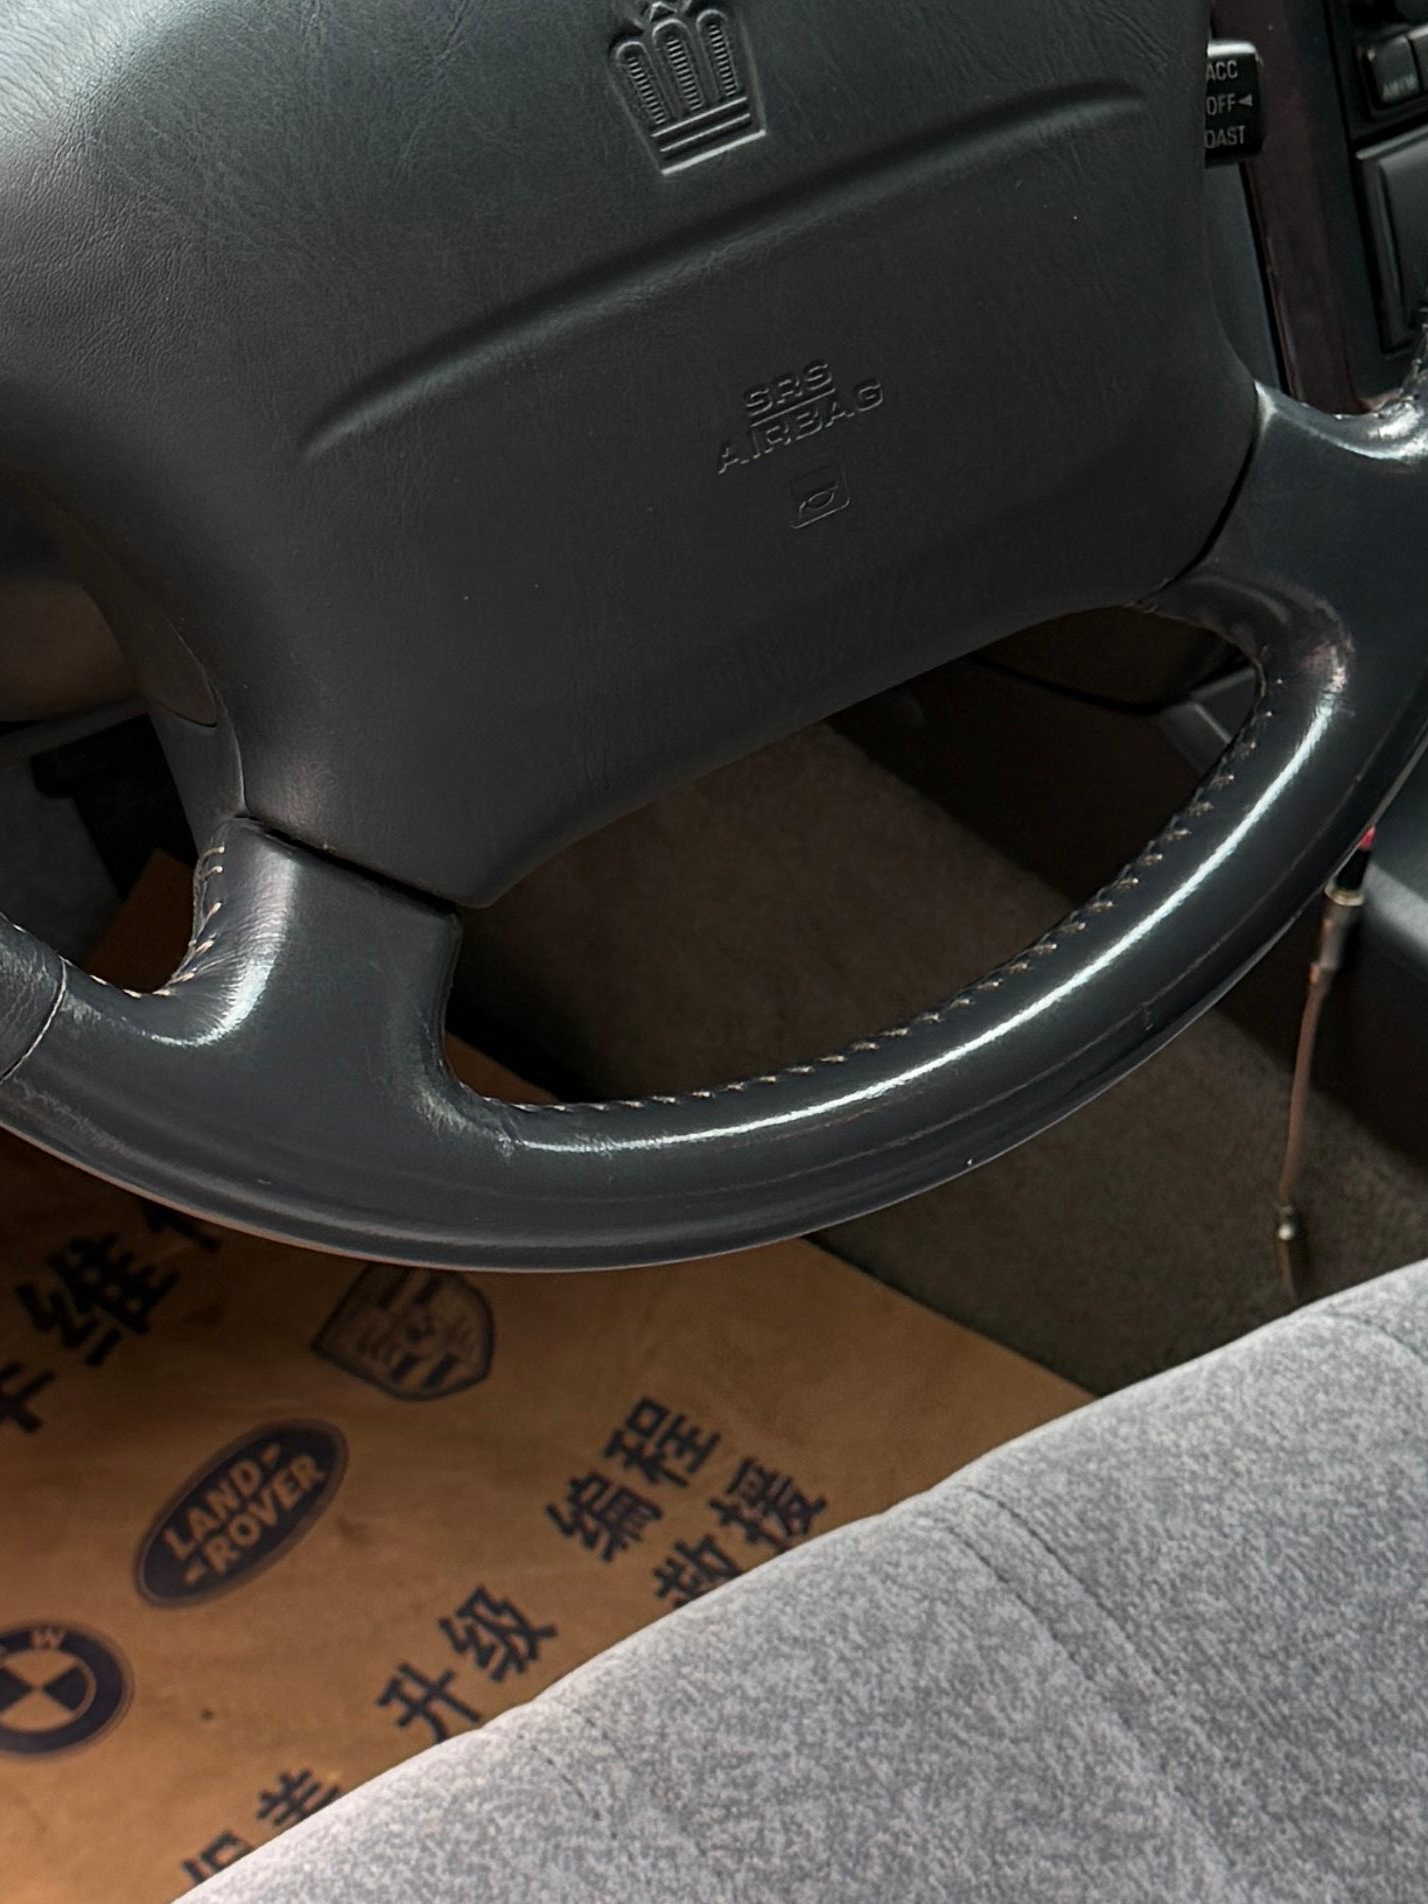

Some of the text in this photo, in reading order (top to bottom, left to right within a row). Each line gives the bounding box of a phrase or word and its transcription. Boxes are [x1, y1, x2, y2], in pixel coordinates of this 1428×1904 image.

[1204, 59, 1239, 82] ACC
[1205, 92, 1236, 117] OFF
[743, 359, 833, 417] SRS
[717, 377, 885, 476] AIRBAG
[378, 1586, 558, 1743] 升级
[546, 1396, 721, 1563] 编程
